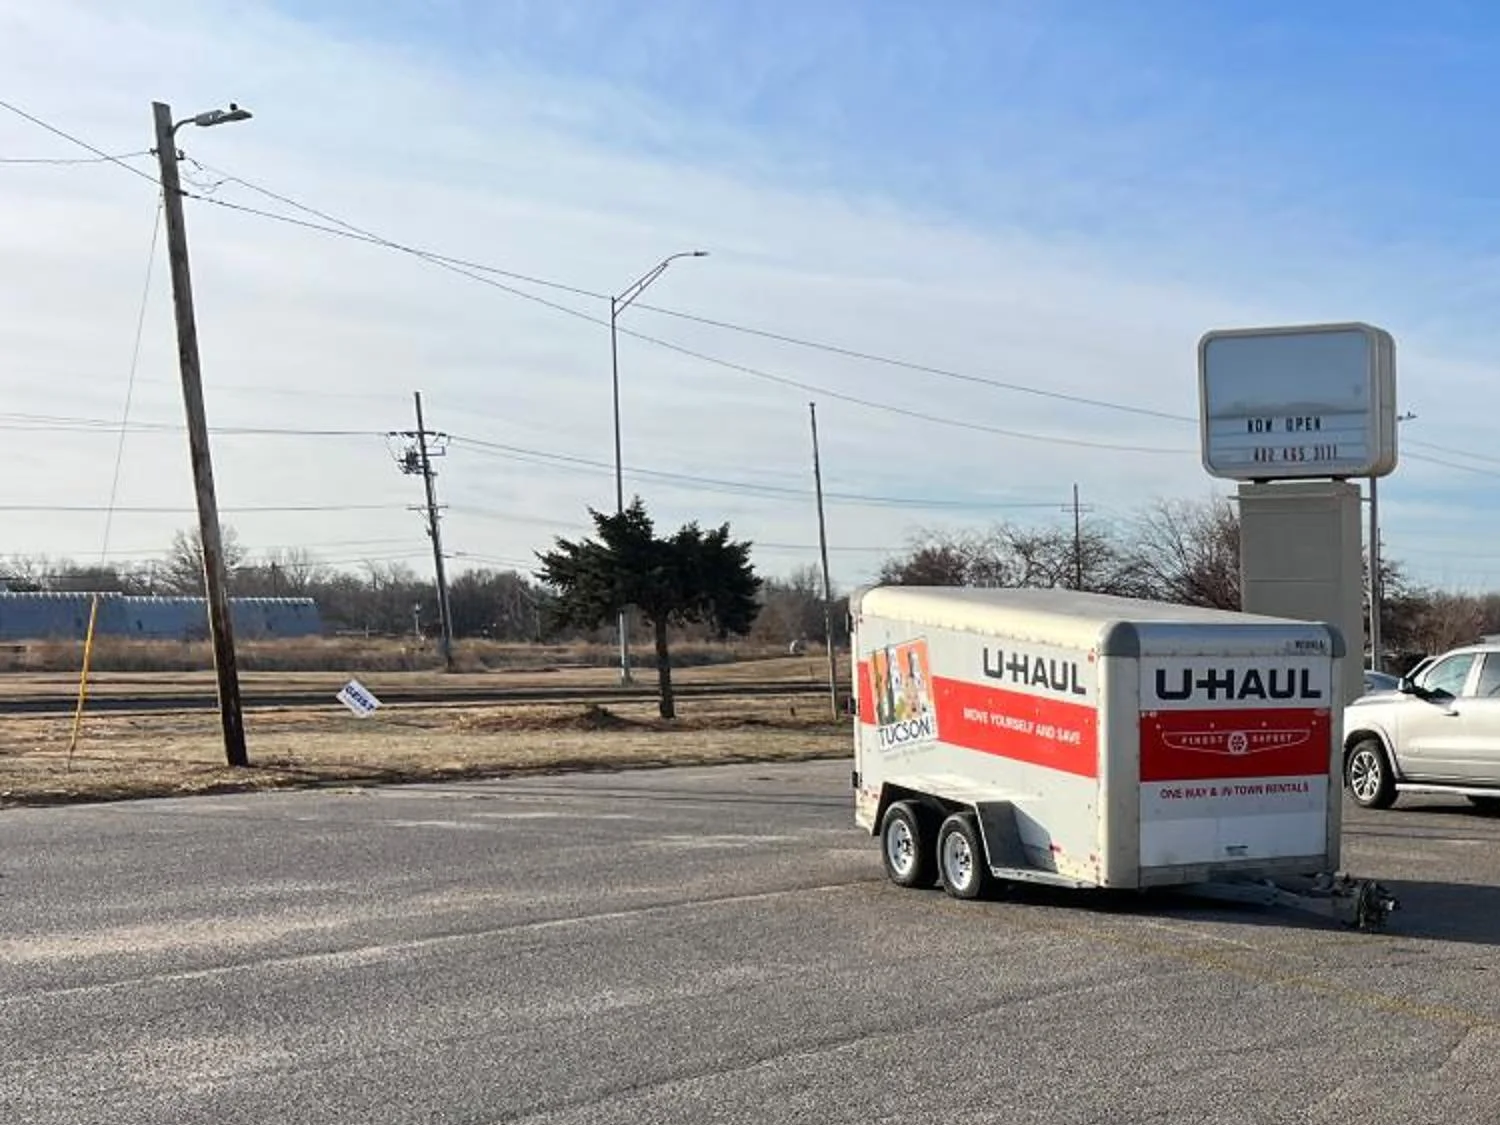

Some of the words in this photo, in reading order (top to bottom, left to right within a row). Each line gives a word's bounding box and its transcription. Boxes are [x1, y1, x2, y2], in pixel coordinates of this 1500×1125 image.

[1247, 418, 1273, 433] NOW
[1285, 416, 1321, 433] OPEN
[983, 647, 1087, 695] U-HAUL
[1155, 668, 1322, 700] U-HAUL
[876, 717, 931, 747] TUCSON
[963, 707, 988, 724] MOVE
[989, 713, 1034, 734] YOURSELF
[1056, 727, 1081, 745] SAVE
[1265, 781, 1309, 794] RENTALS
